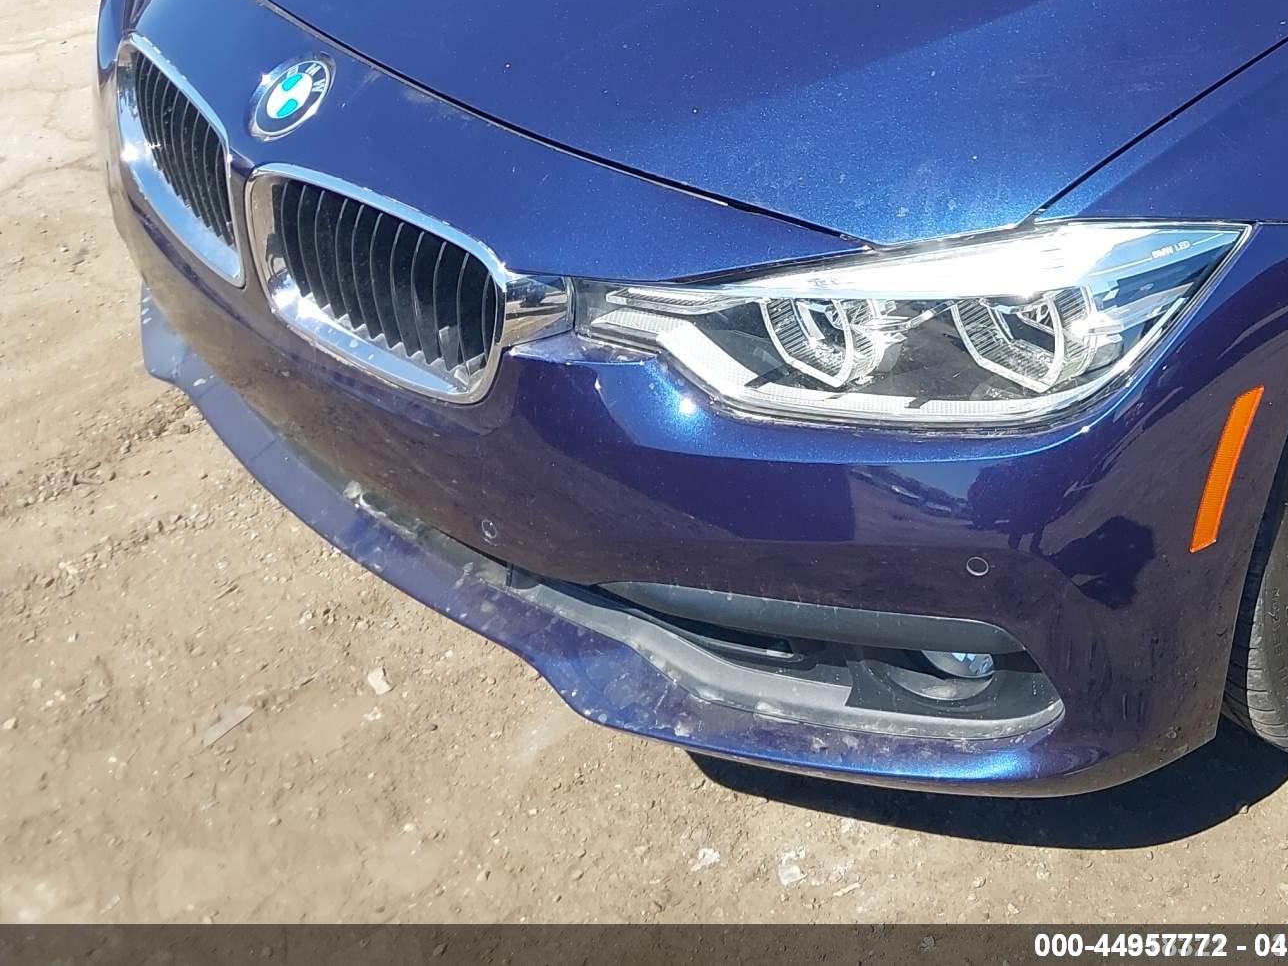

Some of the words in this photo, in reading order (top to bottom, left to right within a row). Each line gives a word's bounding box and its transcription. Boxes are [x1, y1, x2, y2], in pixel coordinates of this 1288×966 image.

[285, 62, 327, 93] BMW
[1150, 245, 1174, 259] BMW
[1174, 240, 1191, 251] LED
